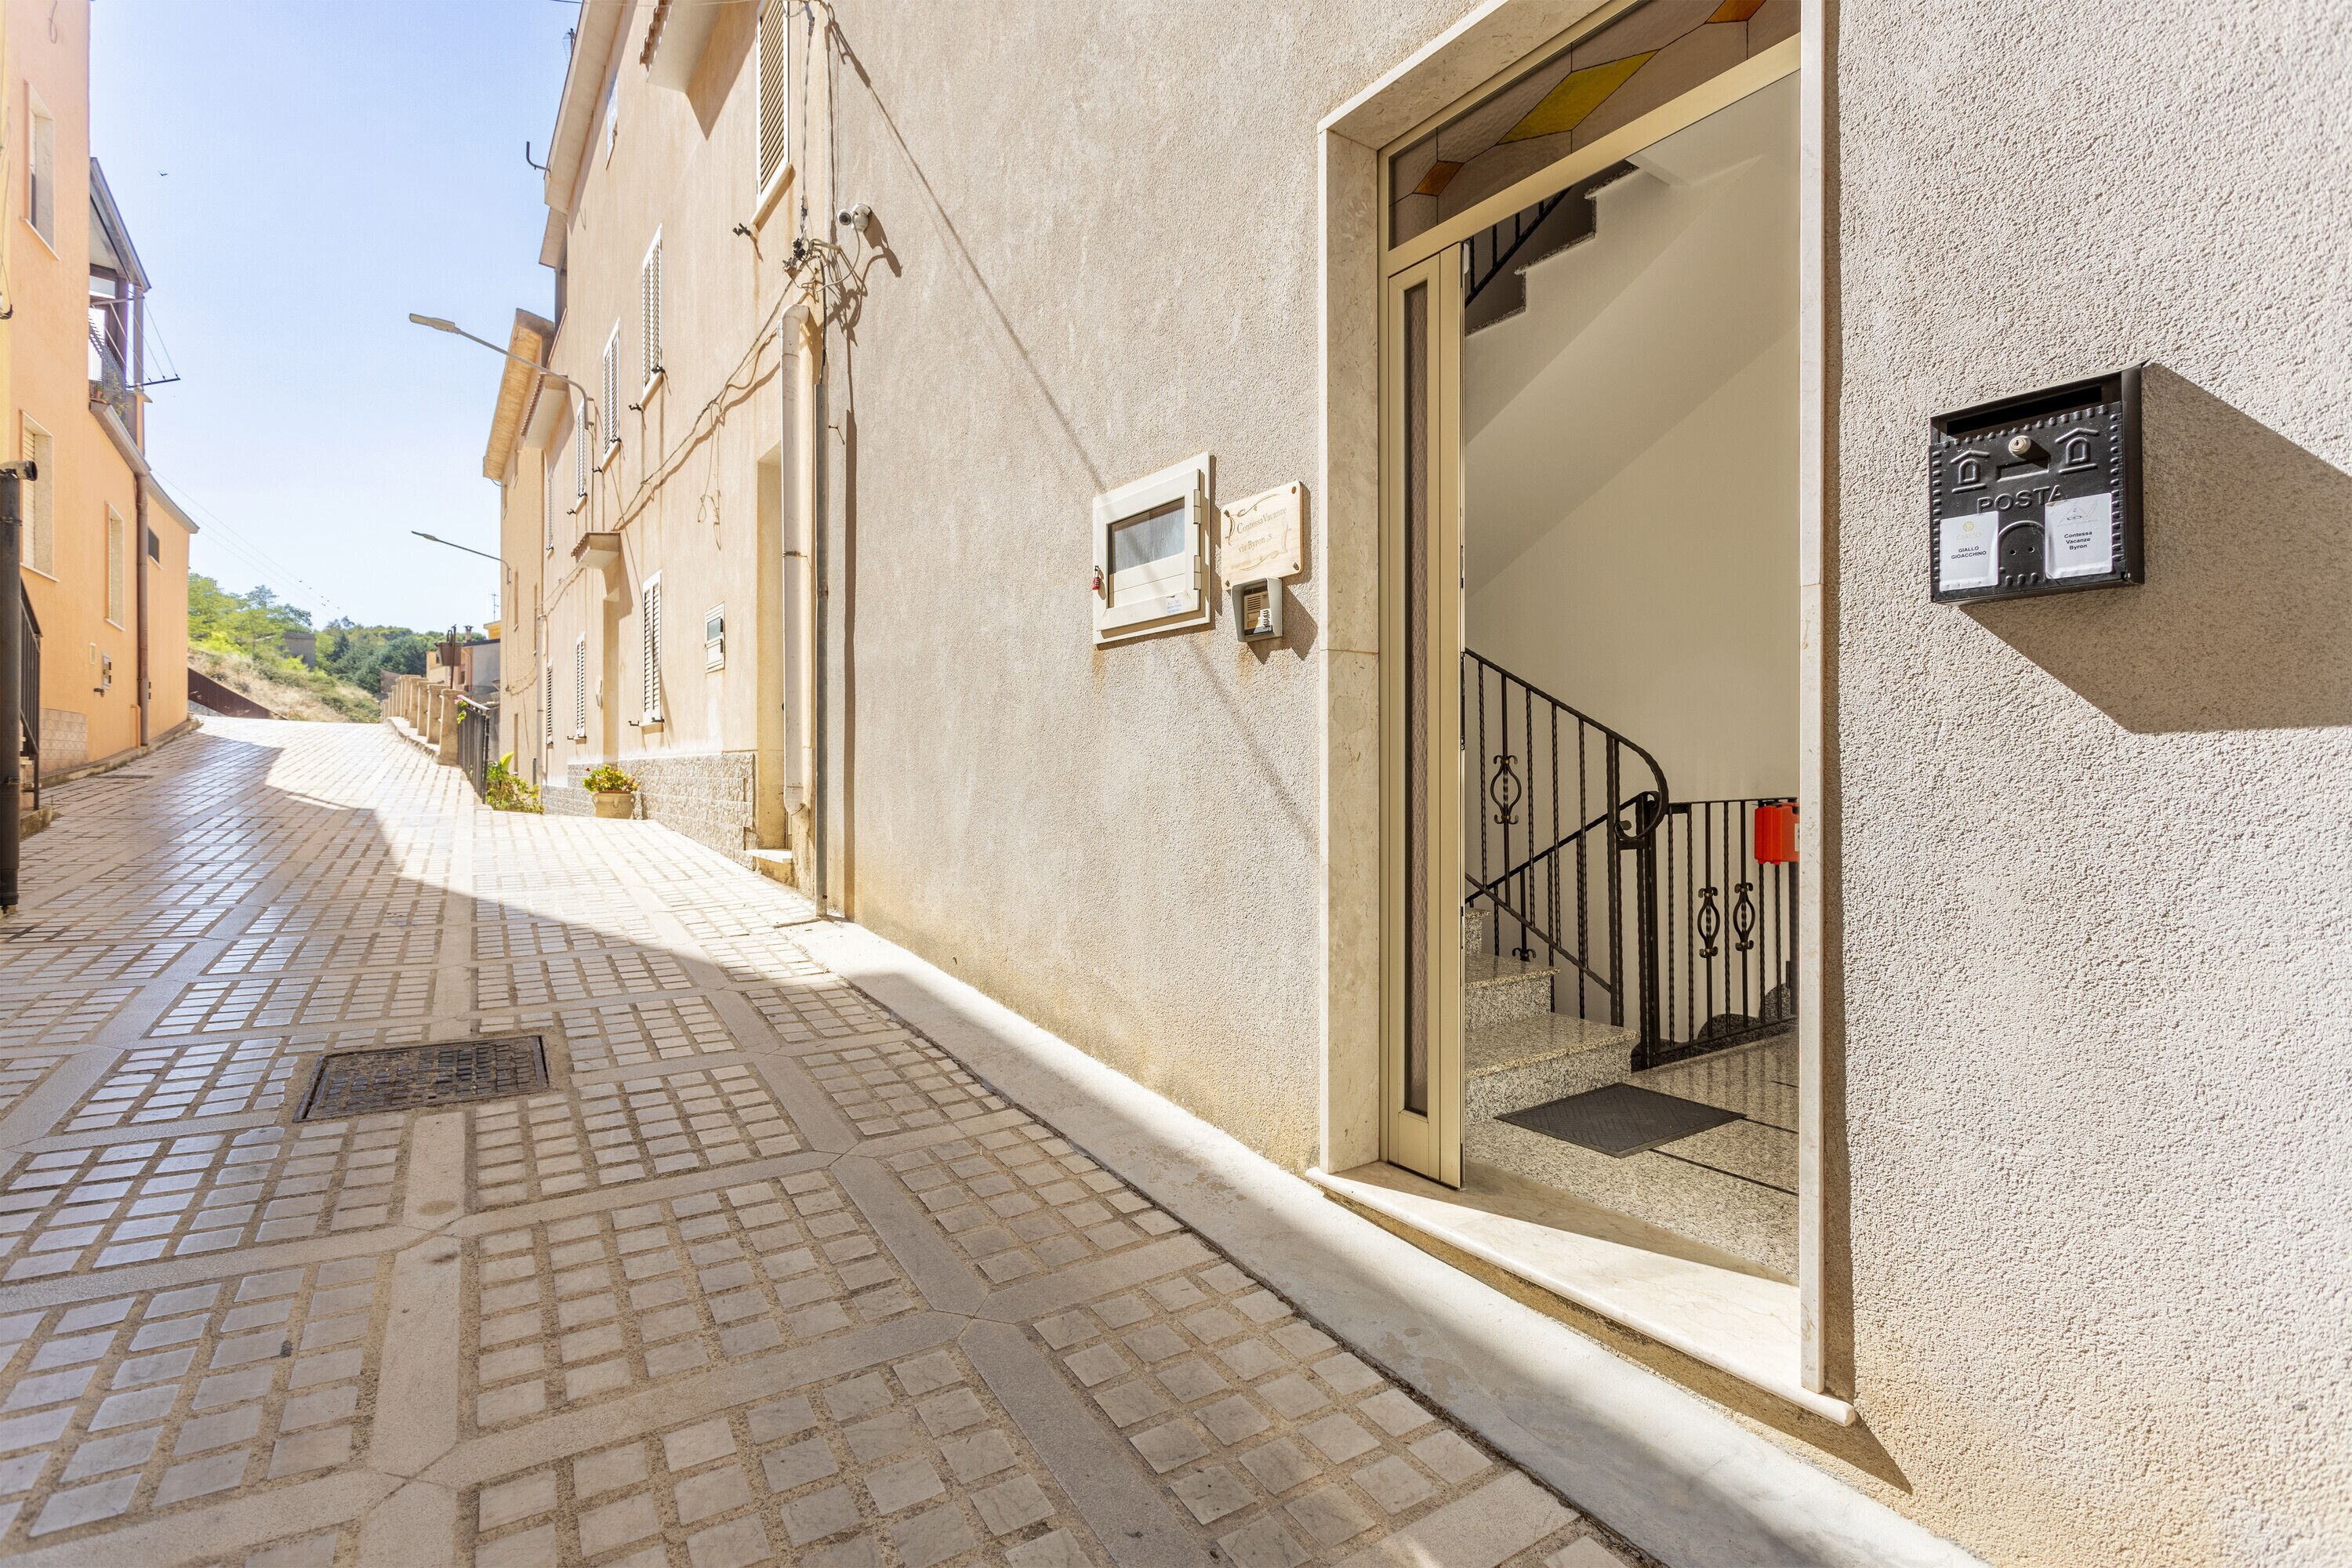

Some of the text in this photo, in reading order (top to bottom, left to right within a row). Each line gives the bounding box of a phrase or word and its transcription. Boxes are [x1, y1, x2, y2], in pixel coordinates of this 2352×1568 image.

[1976, 484, 2066, 514] POSTA
[1237, 508, 1287, 534] Contessa Vacanze
[1247, 536, 1265, 550] Byron
[1951, 550, 1987, 560] GIOACCHINO
